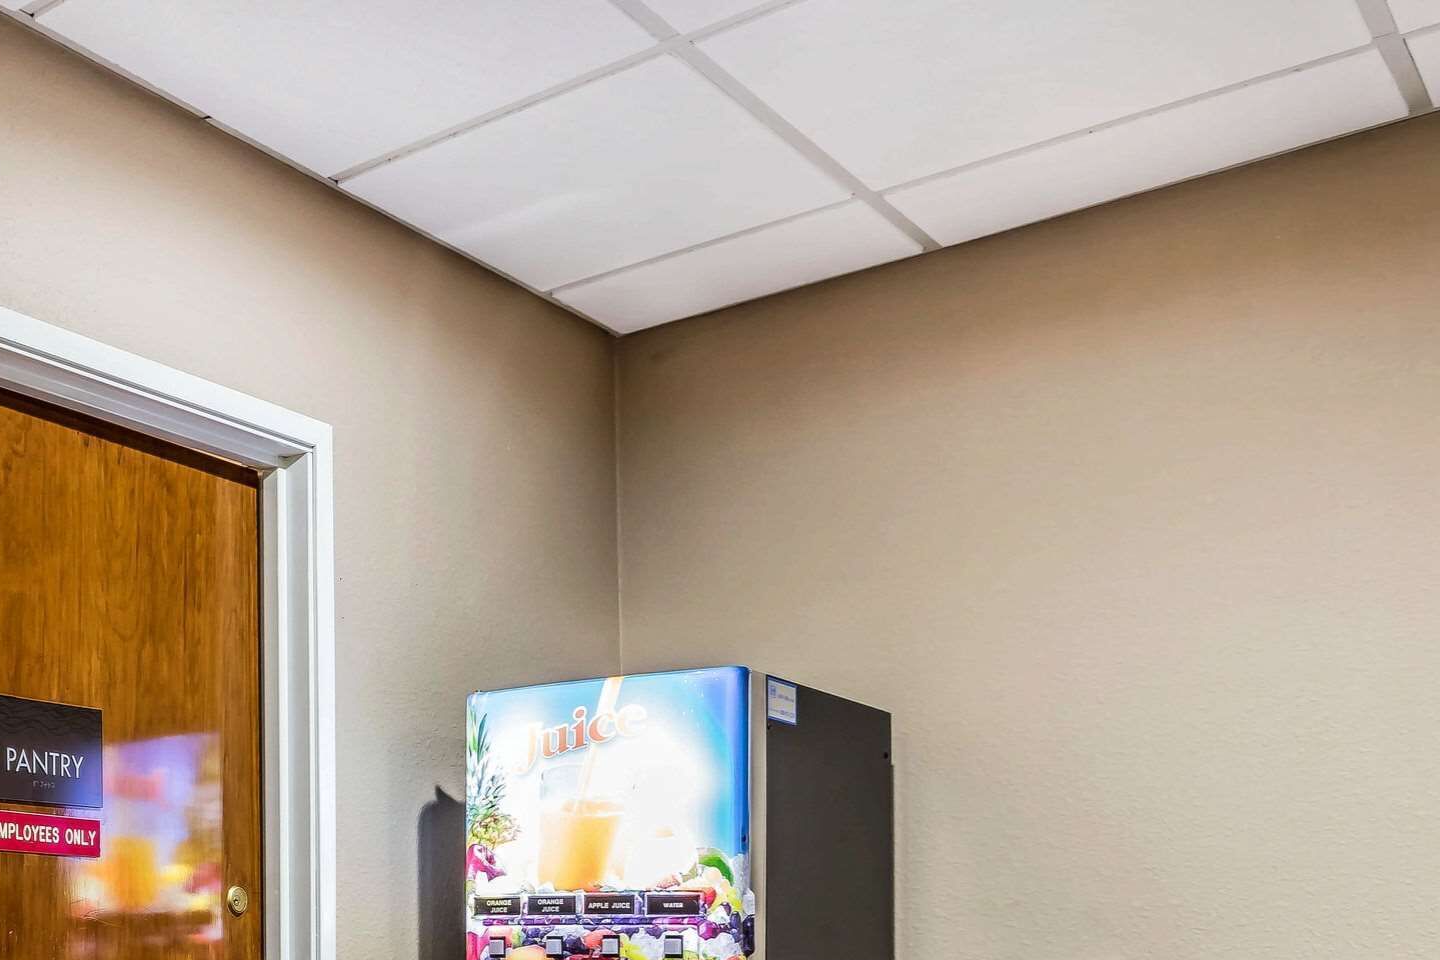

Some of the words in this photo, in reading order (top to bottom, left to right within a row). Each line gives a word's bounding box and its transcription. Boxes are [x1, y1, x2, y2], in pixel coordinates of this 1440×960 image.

[510, 704, 648, 776] Juice
[6, 746, 84, 779] PANTRY
[65, 828, 97, 846] ONLY
